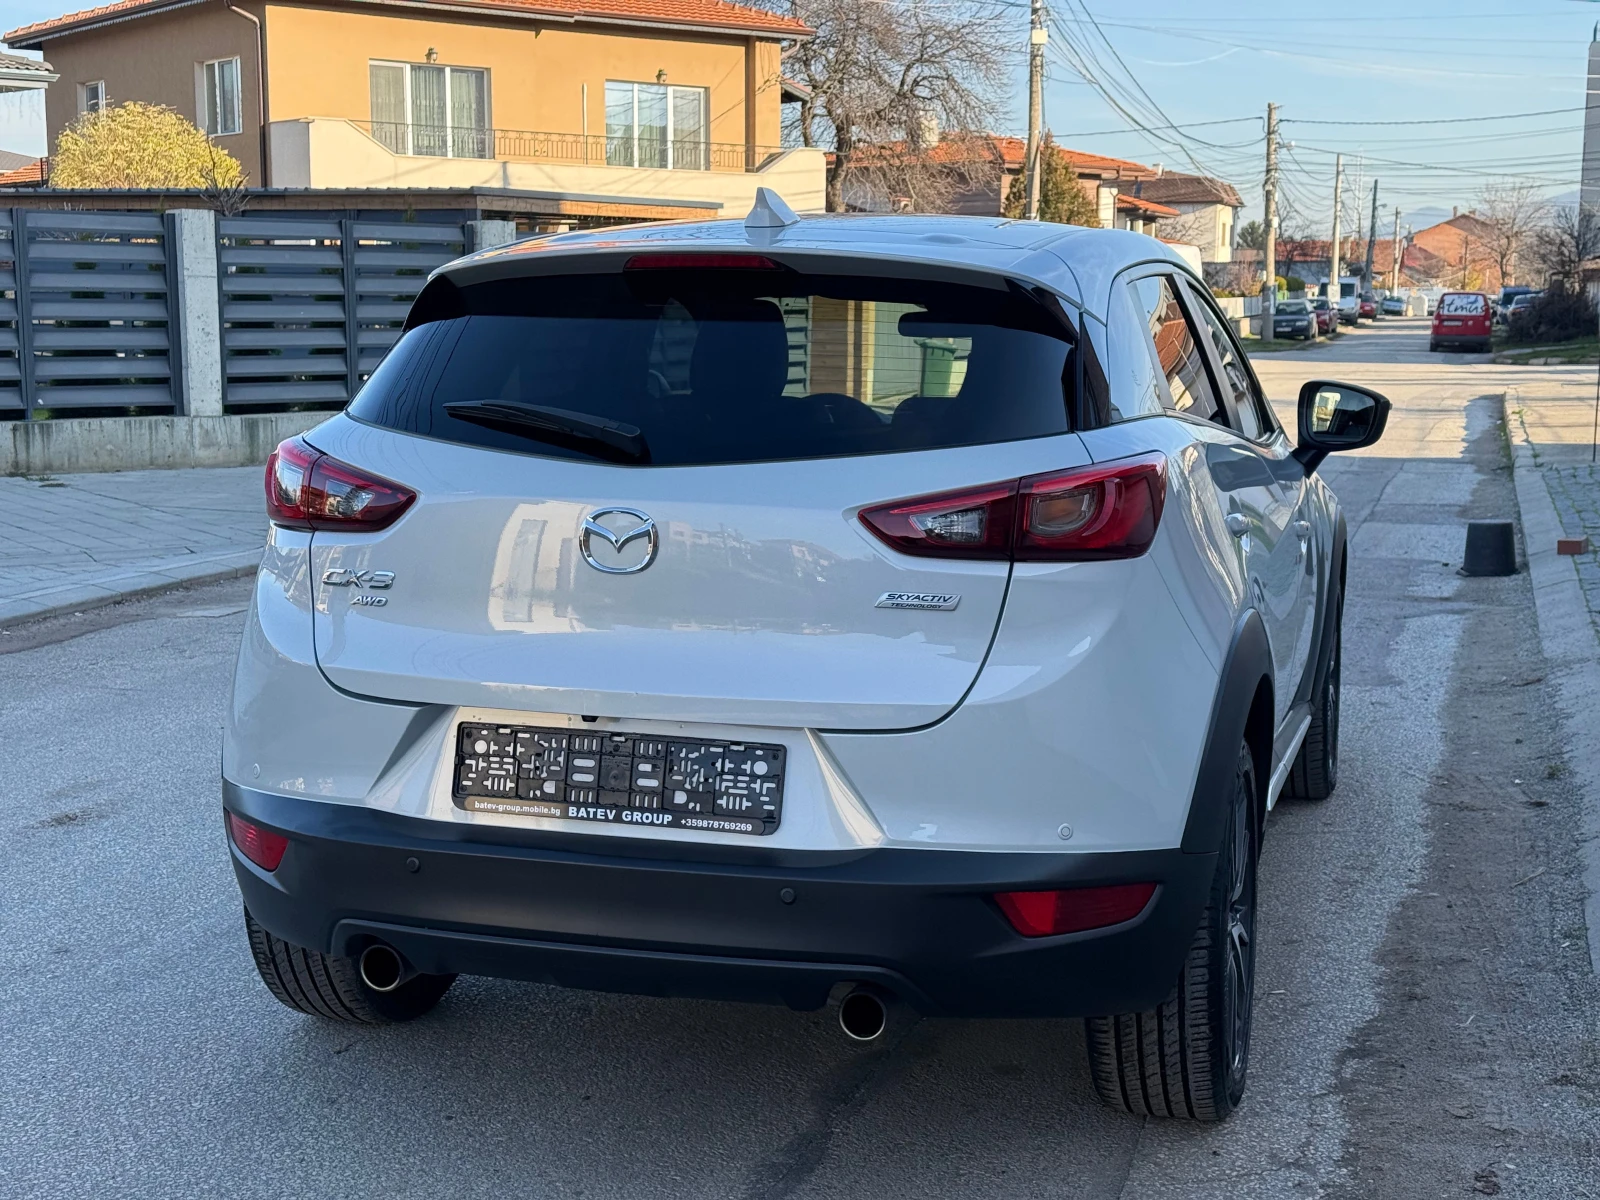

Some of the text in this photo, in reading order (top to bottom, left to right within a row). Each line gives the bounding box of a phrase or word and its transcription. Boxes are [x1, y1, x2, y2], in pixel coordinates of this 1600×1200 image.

[322, 569, 395, 589] CX-3
[350, 596, 388, 607] AWD
[886, 593, 952, 603] SKYACTIV
[474, 800, 561, 816] batev-group.mobile.bg
[568, 806, 673, 825] BATEV GROUP
[681, 818, 753, 832] +359878769269
